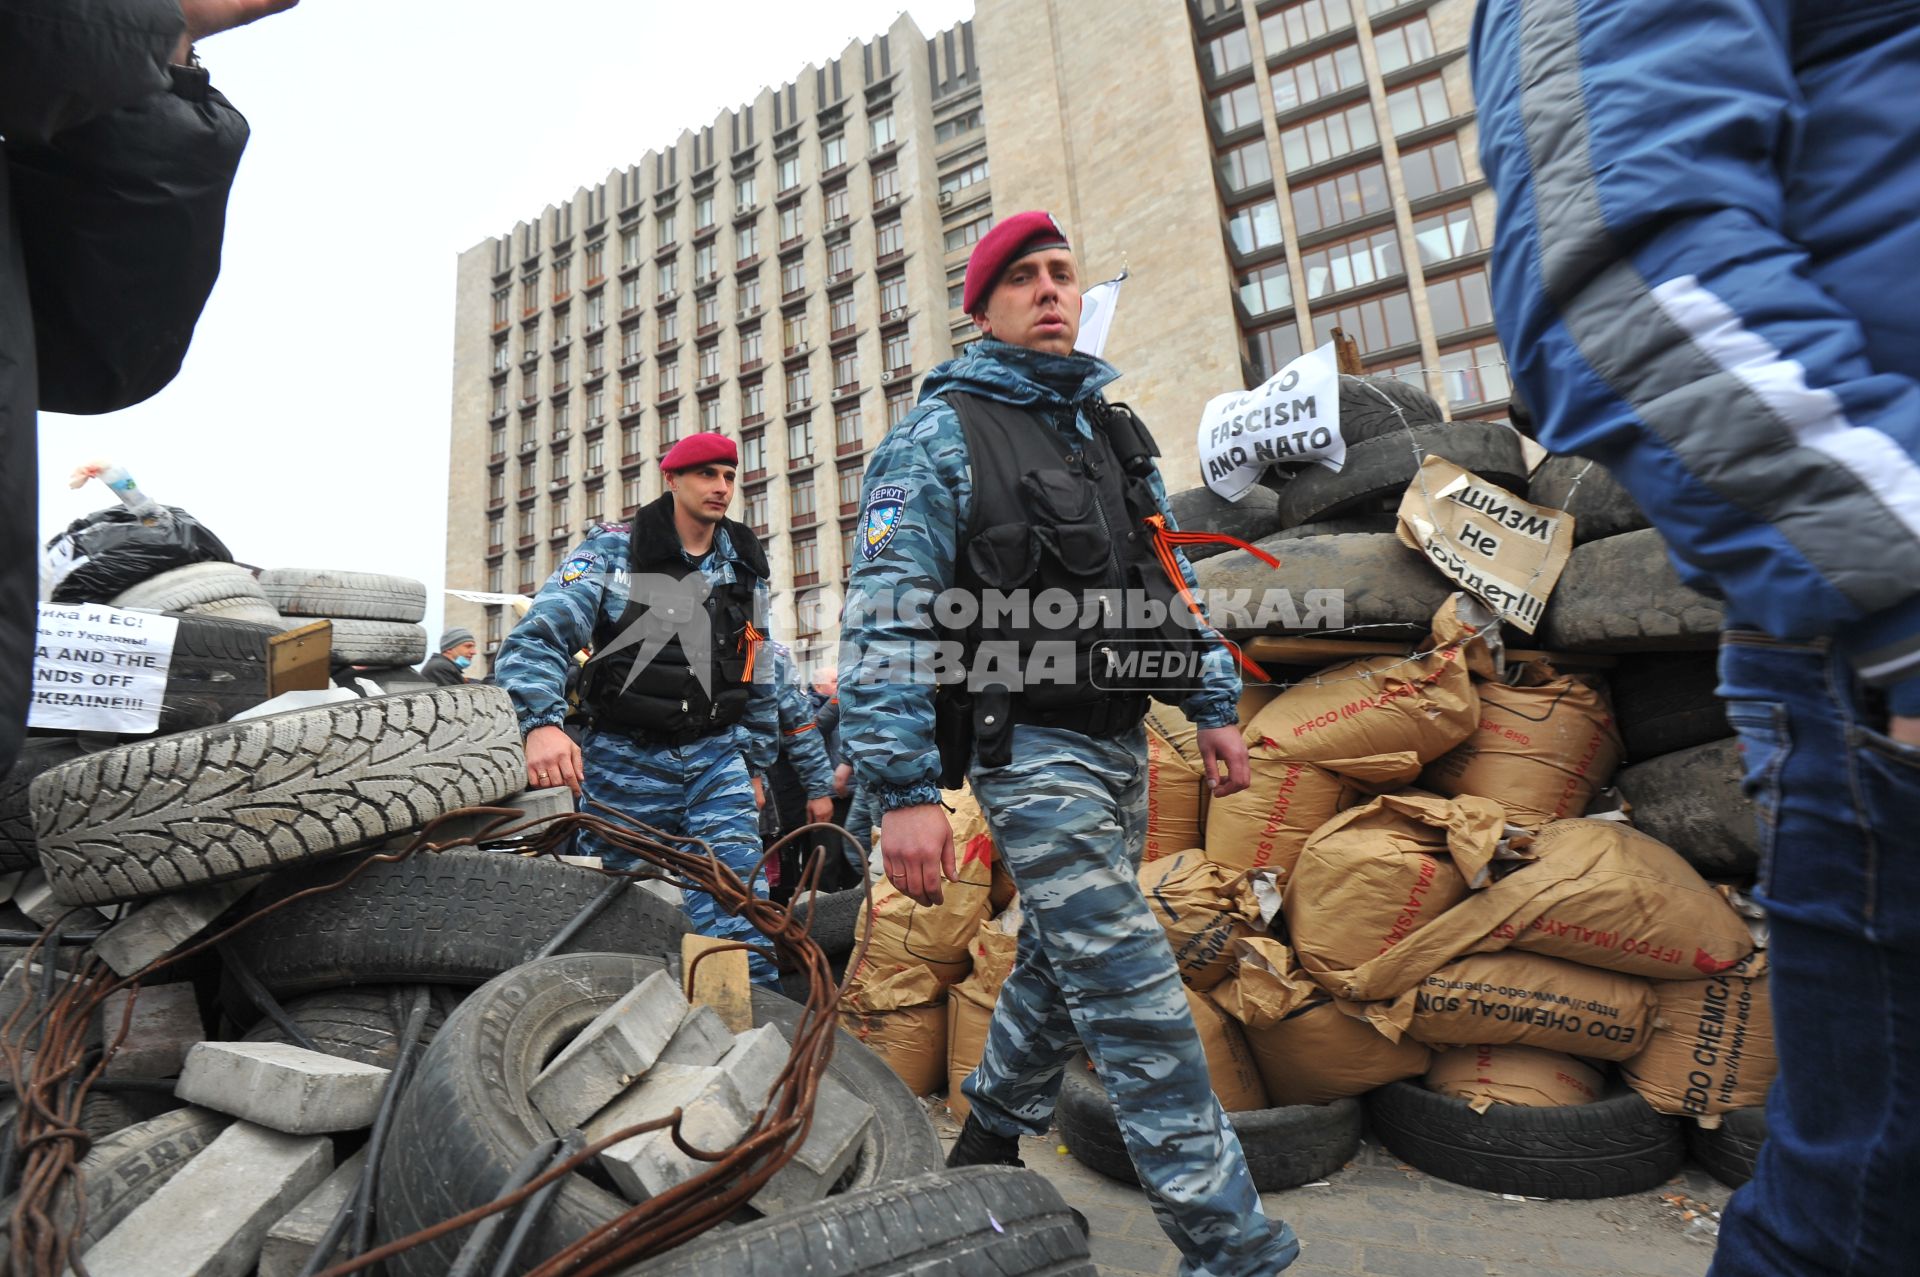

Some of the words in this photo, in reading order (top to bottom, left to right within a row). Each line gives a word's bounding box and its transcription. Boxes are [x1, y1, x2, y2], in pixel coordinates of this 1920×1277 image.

[1210, 395, 1318, 449] FASCISM
[1208, 446, 1249, 482] AND
[1253, 426, 1332, 462] NATO
[870, 487, 903, 502] БЕРКУТ
[108, 613, 144, 628] ЕС!
[57, 629, 74, 638] от
[77, 630, 148, 646] Украины!
[57, 648, 105, 664] AND
[113, 652, 157, 668] THE
[92, 673, 135, 688] OFF
[1293, 710, 1339, 738] IFFCO
[1622, 937, 1683, 965] IFFCO
[1466, 998, 1581, 1034] CHEMICAL
[1587, 1020, 1637, 1044] EDO
[1683, 1070, 1713, 1116] EDO
